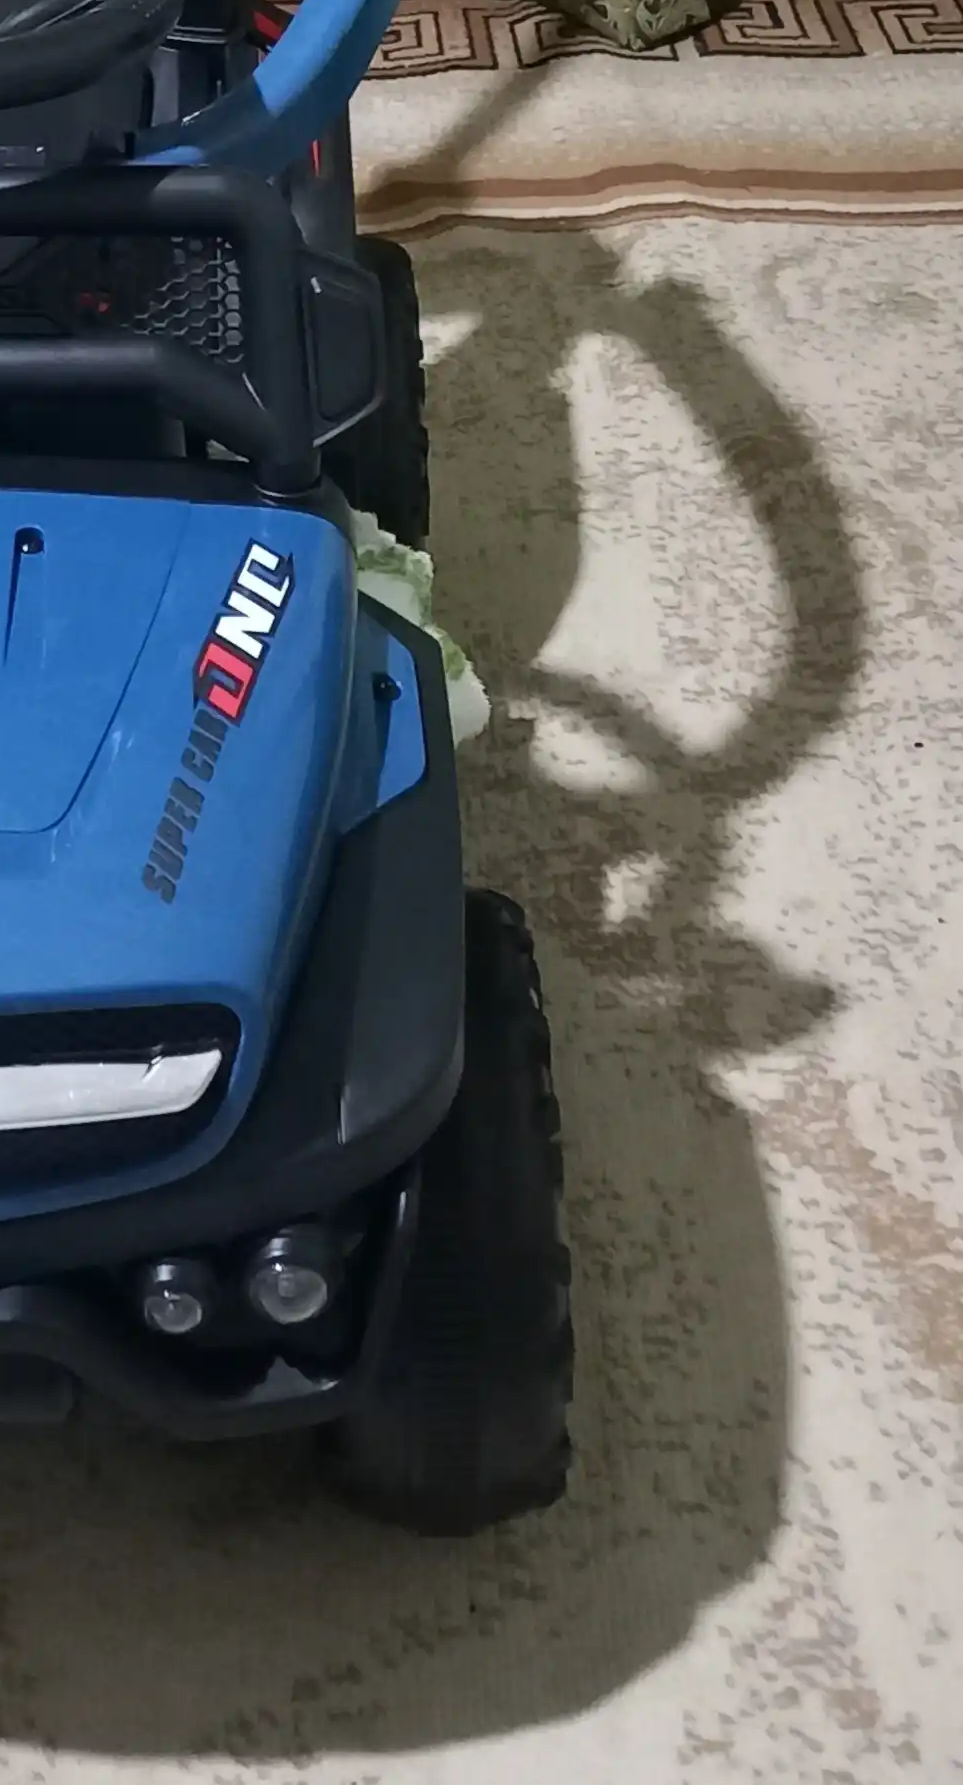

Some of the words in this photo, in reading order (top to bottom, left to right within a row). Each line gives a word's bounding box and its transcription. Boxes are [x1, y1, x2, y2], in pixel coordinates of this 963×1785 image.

[198, 542, 290, 718] JNC
[141, 776, 205, 905] SUPER
[181, 708, 229, 783] CAR
